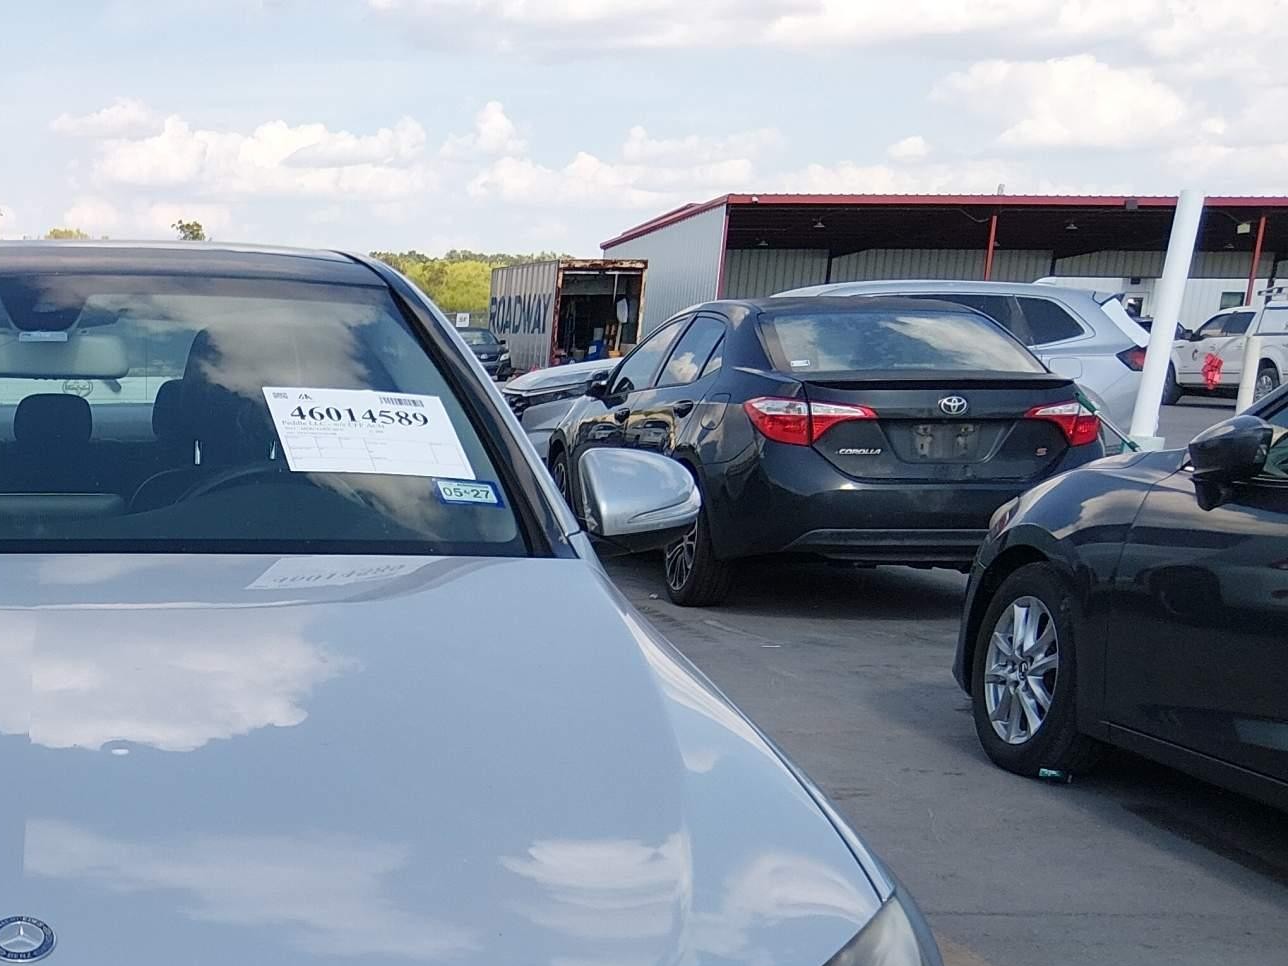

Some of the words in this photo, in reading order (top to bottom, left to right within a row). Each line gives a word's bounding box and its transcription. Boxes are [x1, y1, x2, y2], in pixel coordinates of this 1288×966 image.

[490, 293, 552, 335] ROADWAY
[290, 405, 429, 428] 46014589
[838, 448, 882, 456] COROLLA
